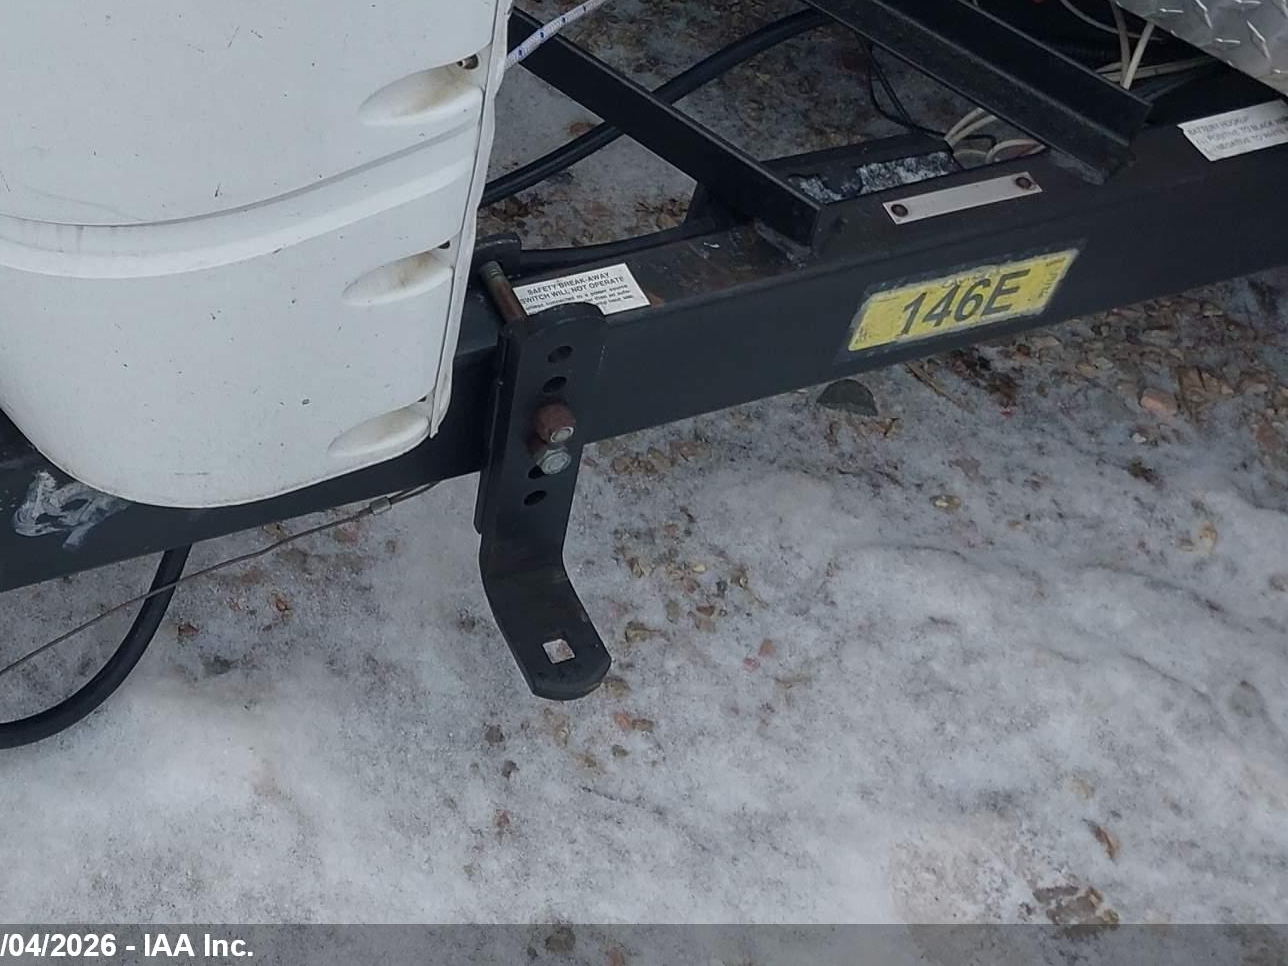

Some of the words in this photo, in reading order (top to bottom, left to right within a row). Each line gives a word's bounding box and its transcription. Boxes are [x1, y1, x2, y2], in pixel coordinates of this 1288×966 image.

[520, 292, 552, 305] SWITCH
[572, 282, 589, 293] NOT
[588, 276, 625, 290] OPERATE
[527, 283, 558, 296] SAFETY
[558, 272, 610, 289] BREAK-AWAY
[897, 268, 1031, 336] 146E
